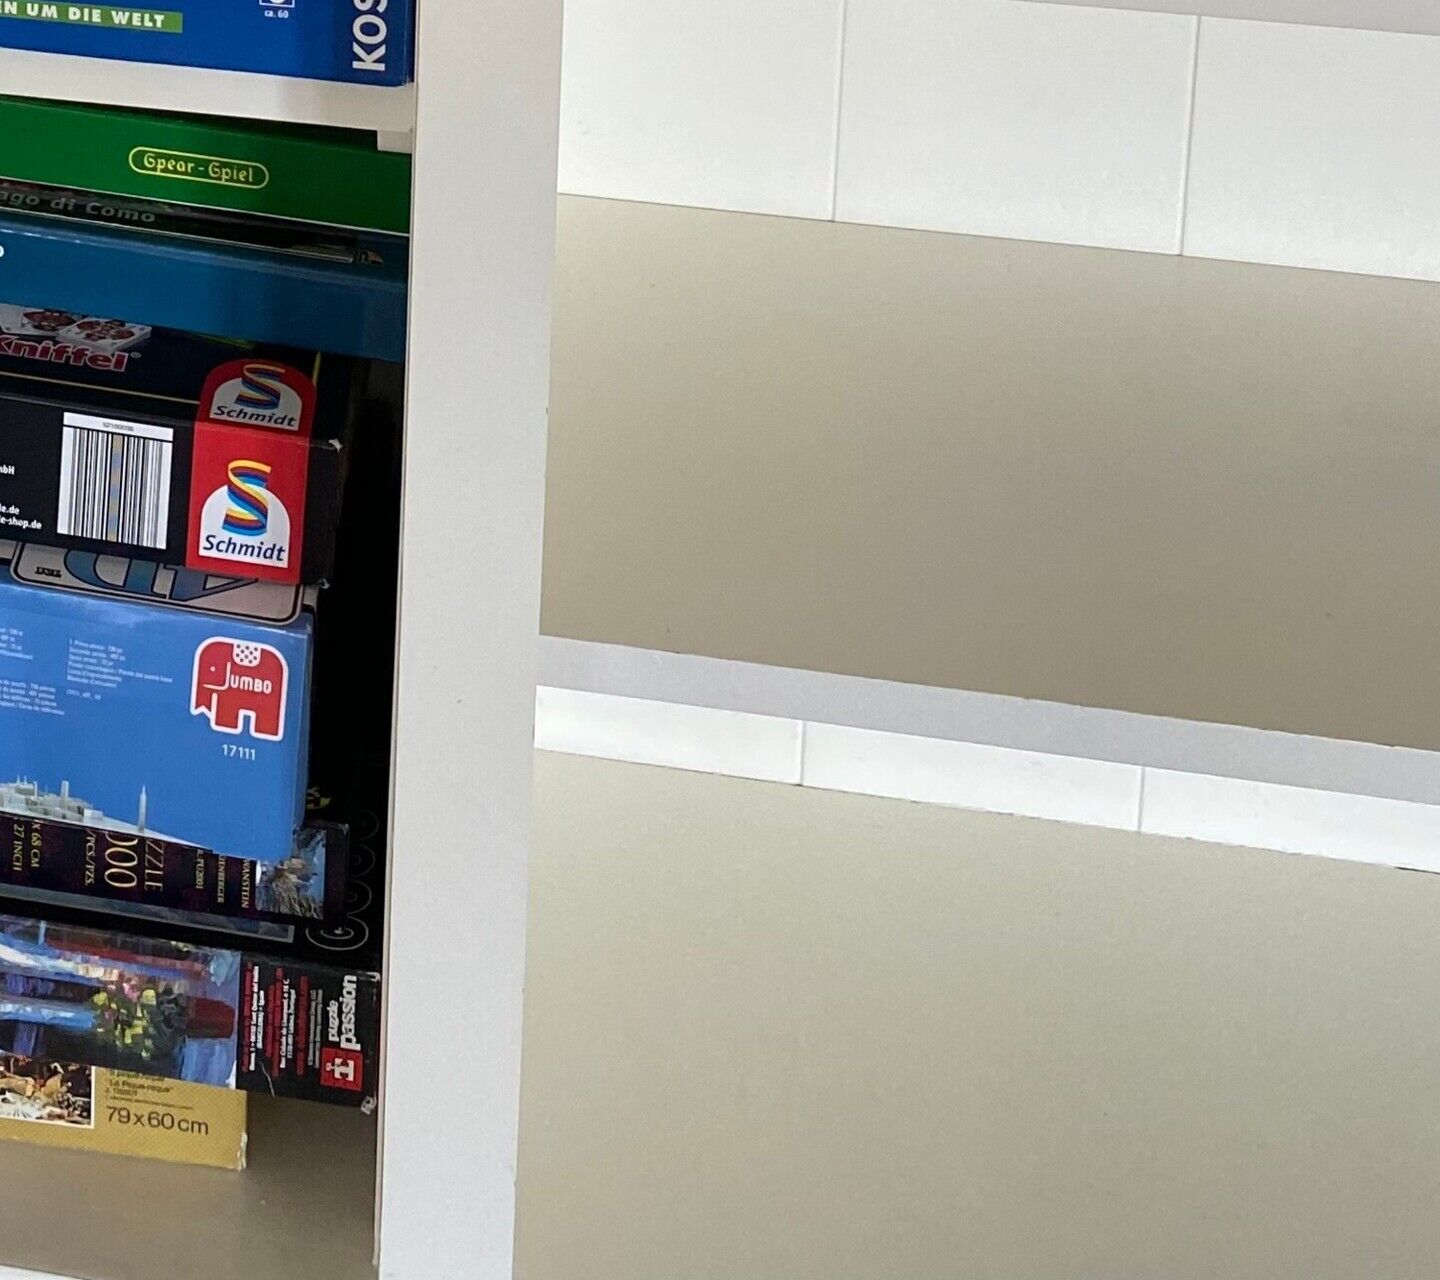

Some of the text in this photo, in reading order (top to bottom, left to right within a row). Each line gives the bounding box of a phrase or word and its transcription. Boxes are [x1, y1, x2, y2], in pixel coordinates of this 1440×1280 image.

[26, 2, 59, 20] UM
[68, 6, 103, 24] DIE
[110, 10, 166, 29] WELT
[85, 202, 156, 224] Como
[214, 404, 298, 428] Schmidt
[202, 534, 287, 562] Schmidt
[221, 743, 257, 761] 17111
[326, 999, 340, 1042] puzzle
[340, 974, 362, 1051] passion
